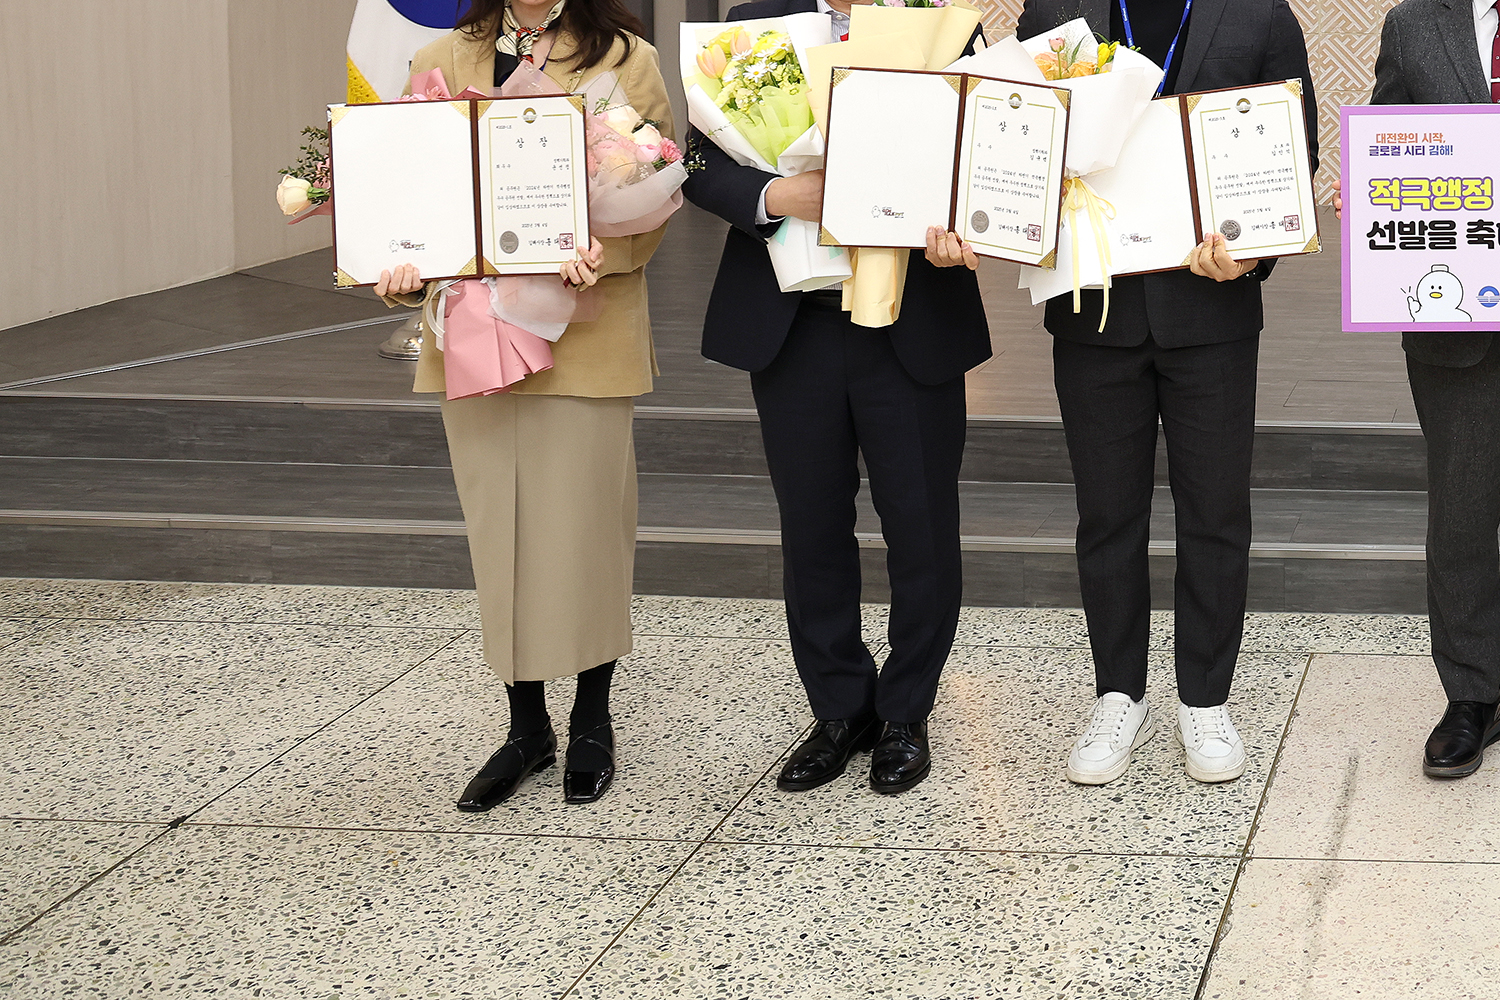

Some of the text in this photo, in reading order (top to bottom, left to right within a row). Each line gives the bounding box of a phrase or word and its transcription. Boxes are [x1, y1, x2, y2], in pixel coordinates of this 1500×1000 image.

[1375, 132, 1446, 144] 대전환의 시작,
[1368, 144, 1453, 157] 글로컬 시티 김해!
[1368, 176, 1494, 212] 적극행정
[1366, 220, 1458, 251] 선발을
